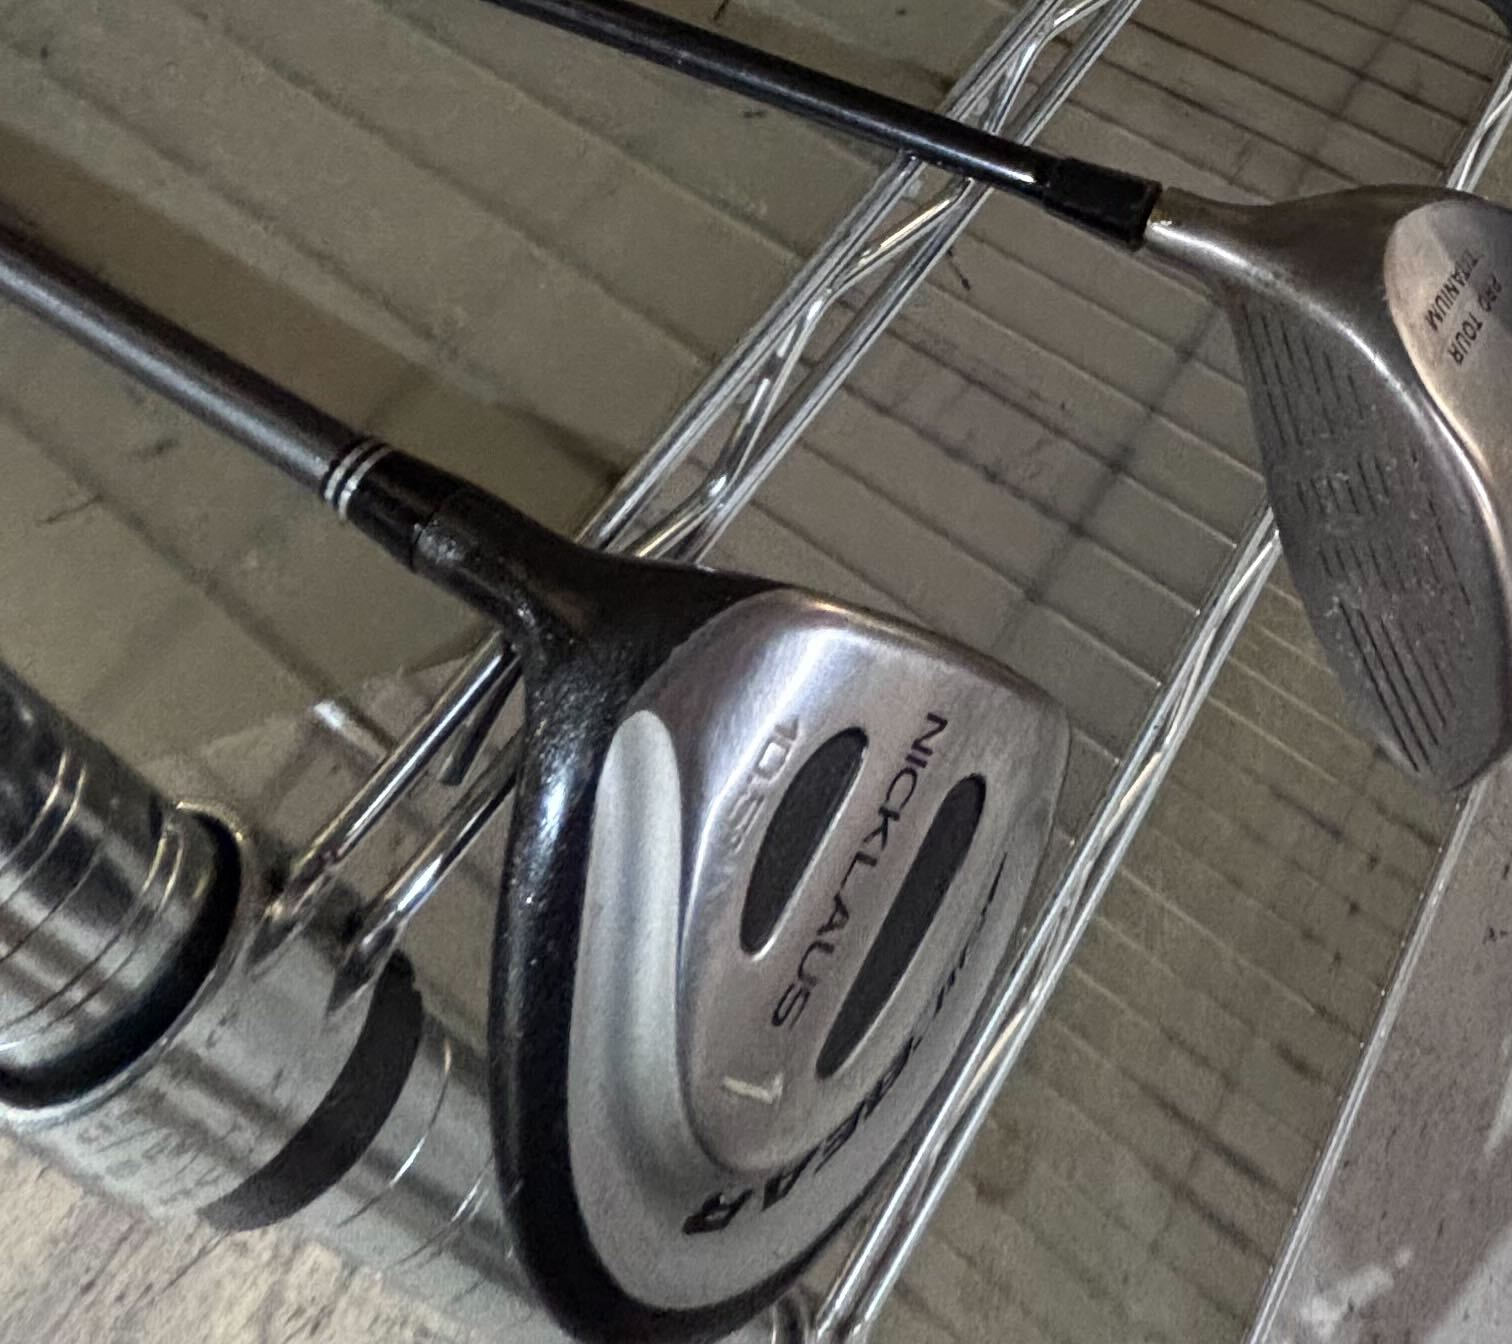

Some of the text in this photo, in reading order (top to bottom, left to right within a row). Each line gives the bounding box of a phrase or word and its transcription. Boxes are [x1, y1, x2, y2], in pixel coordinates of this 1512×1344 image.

[1423, 248, 1482, 333] TITANIUM
[1447, 313, 1486, 366] TOUR
[771, 713, 949, 1028] NICKLAUS
